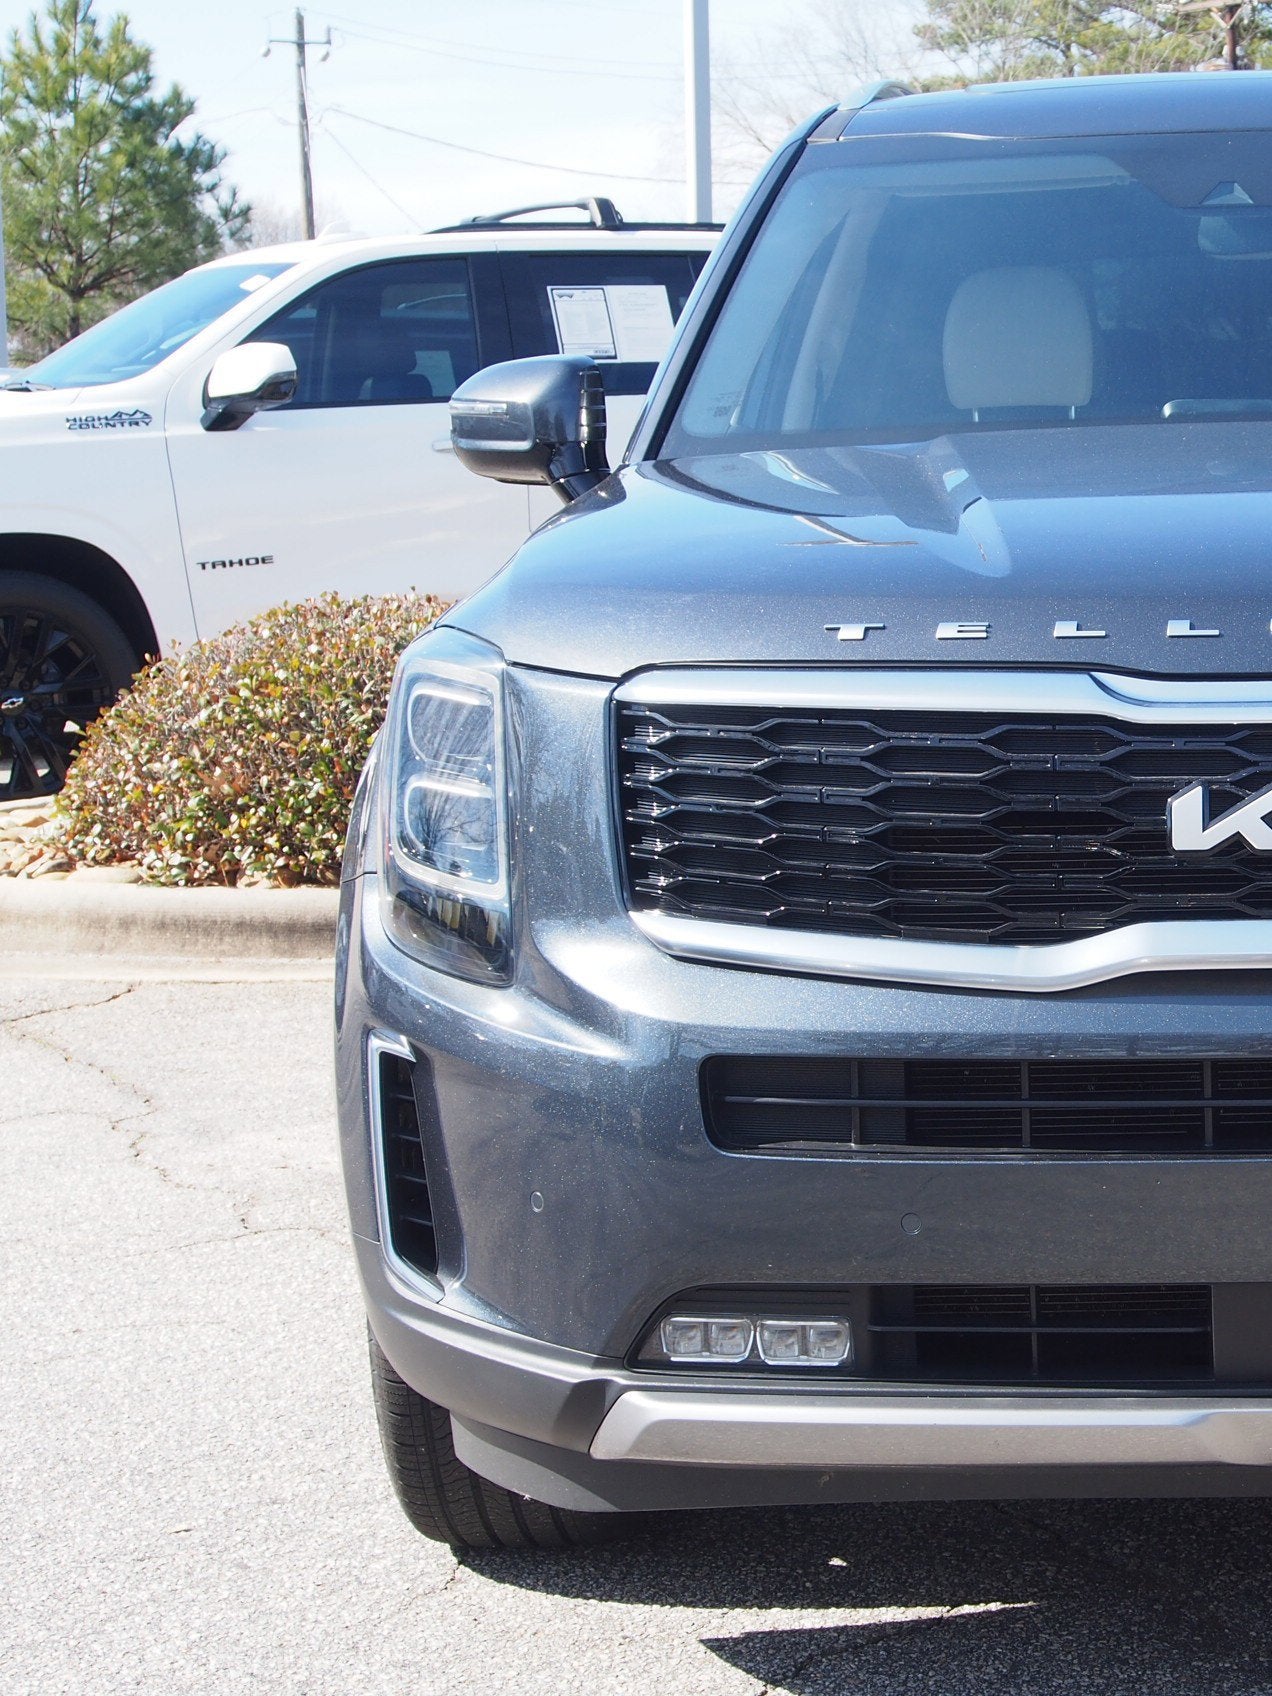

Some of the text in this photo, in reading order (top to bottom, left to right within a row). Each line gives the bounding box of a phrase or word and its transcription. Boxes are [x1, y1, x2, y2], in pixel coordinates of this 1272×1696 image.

[65, 415, 109, 423] HIGH
[67, 419, 153, 431] COUNTRY
[196, 555, 274, 571] TAHOE
